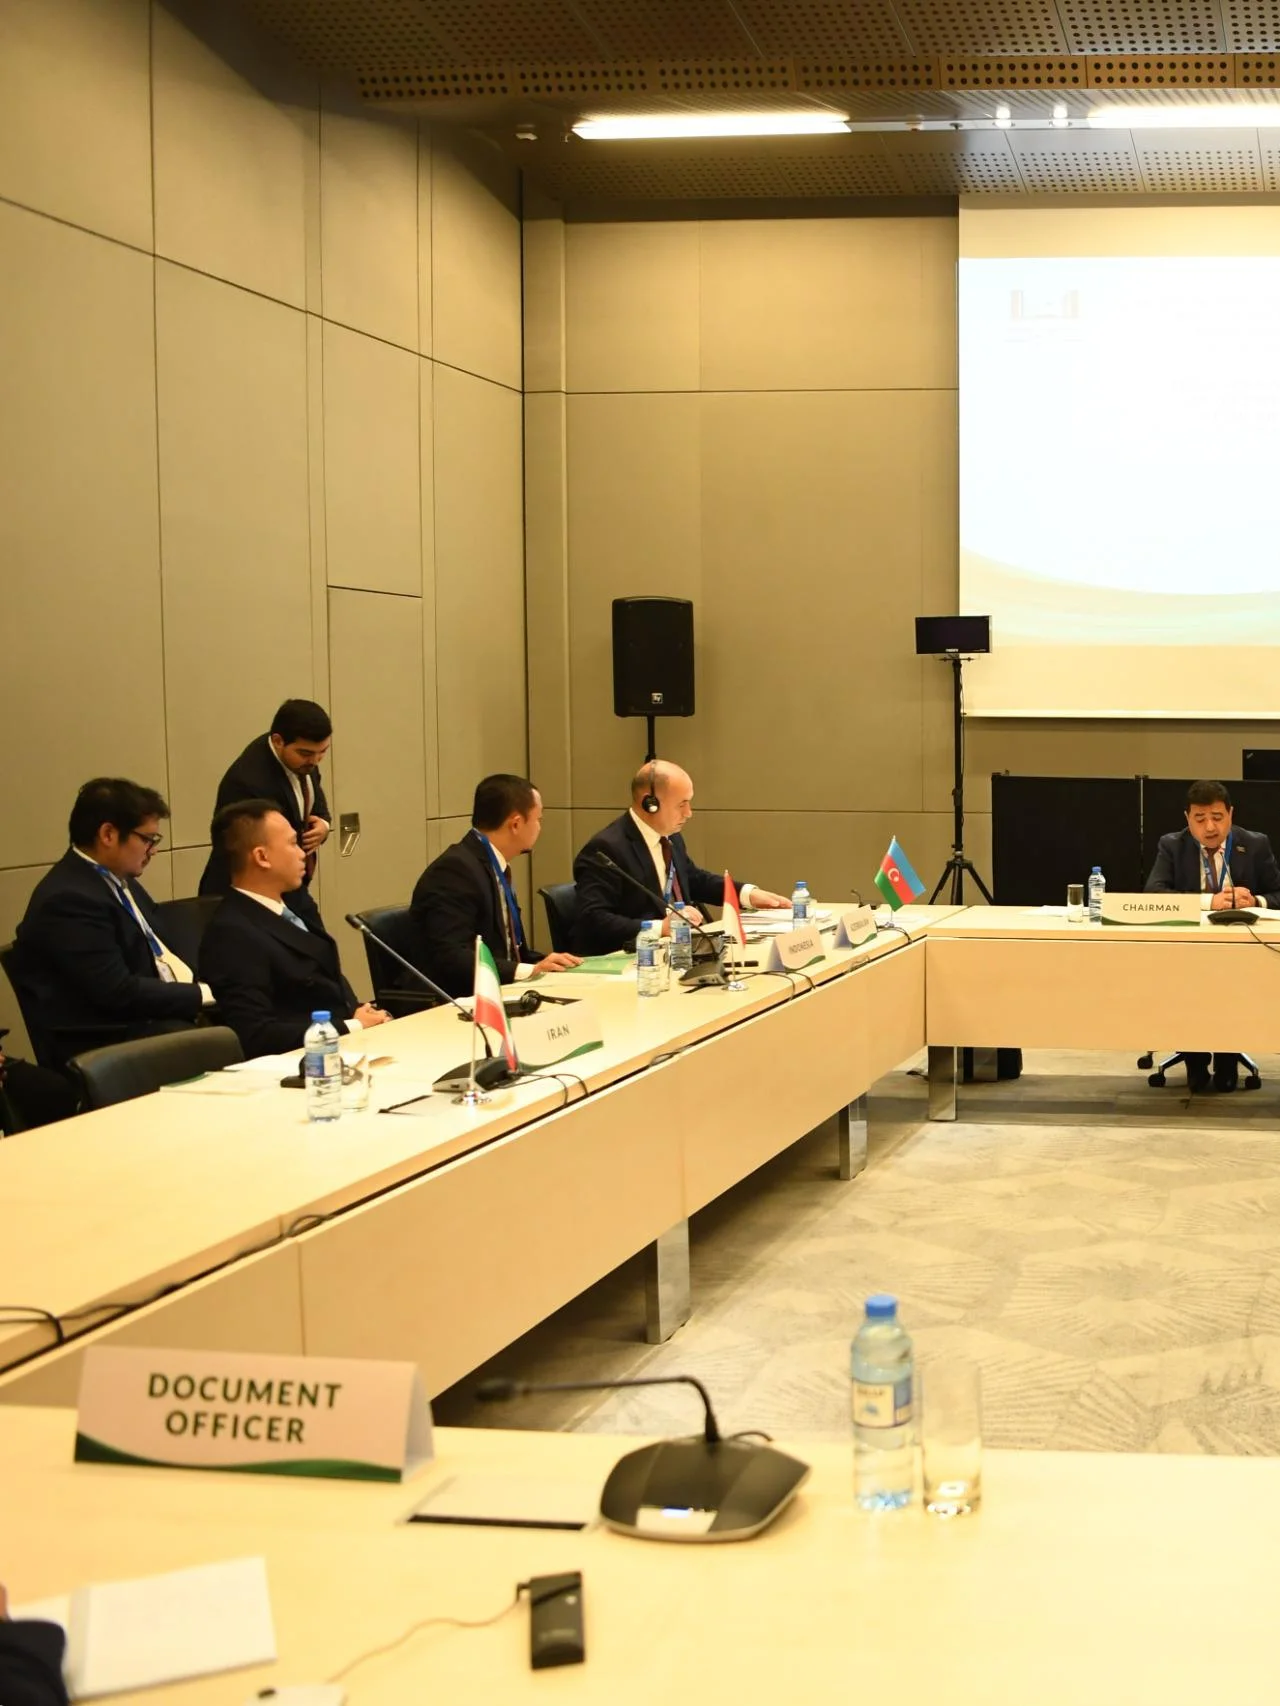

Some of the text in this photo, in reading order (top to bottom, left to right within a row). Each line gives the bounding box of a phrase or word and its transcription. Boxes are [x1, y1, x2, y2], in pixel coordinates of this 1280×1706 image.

[1122, 903, 1180, 912] CHAIRMAN
[546, 1023, 570, 1041] IRAN
[148, 1371, 342, 1410] DOCUMENT
[165, 1409, 306, 1443] OFFICER
